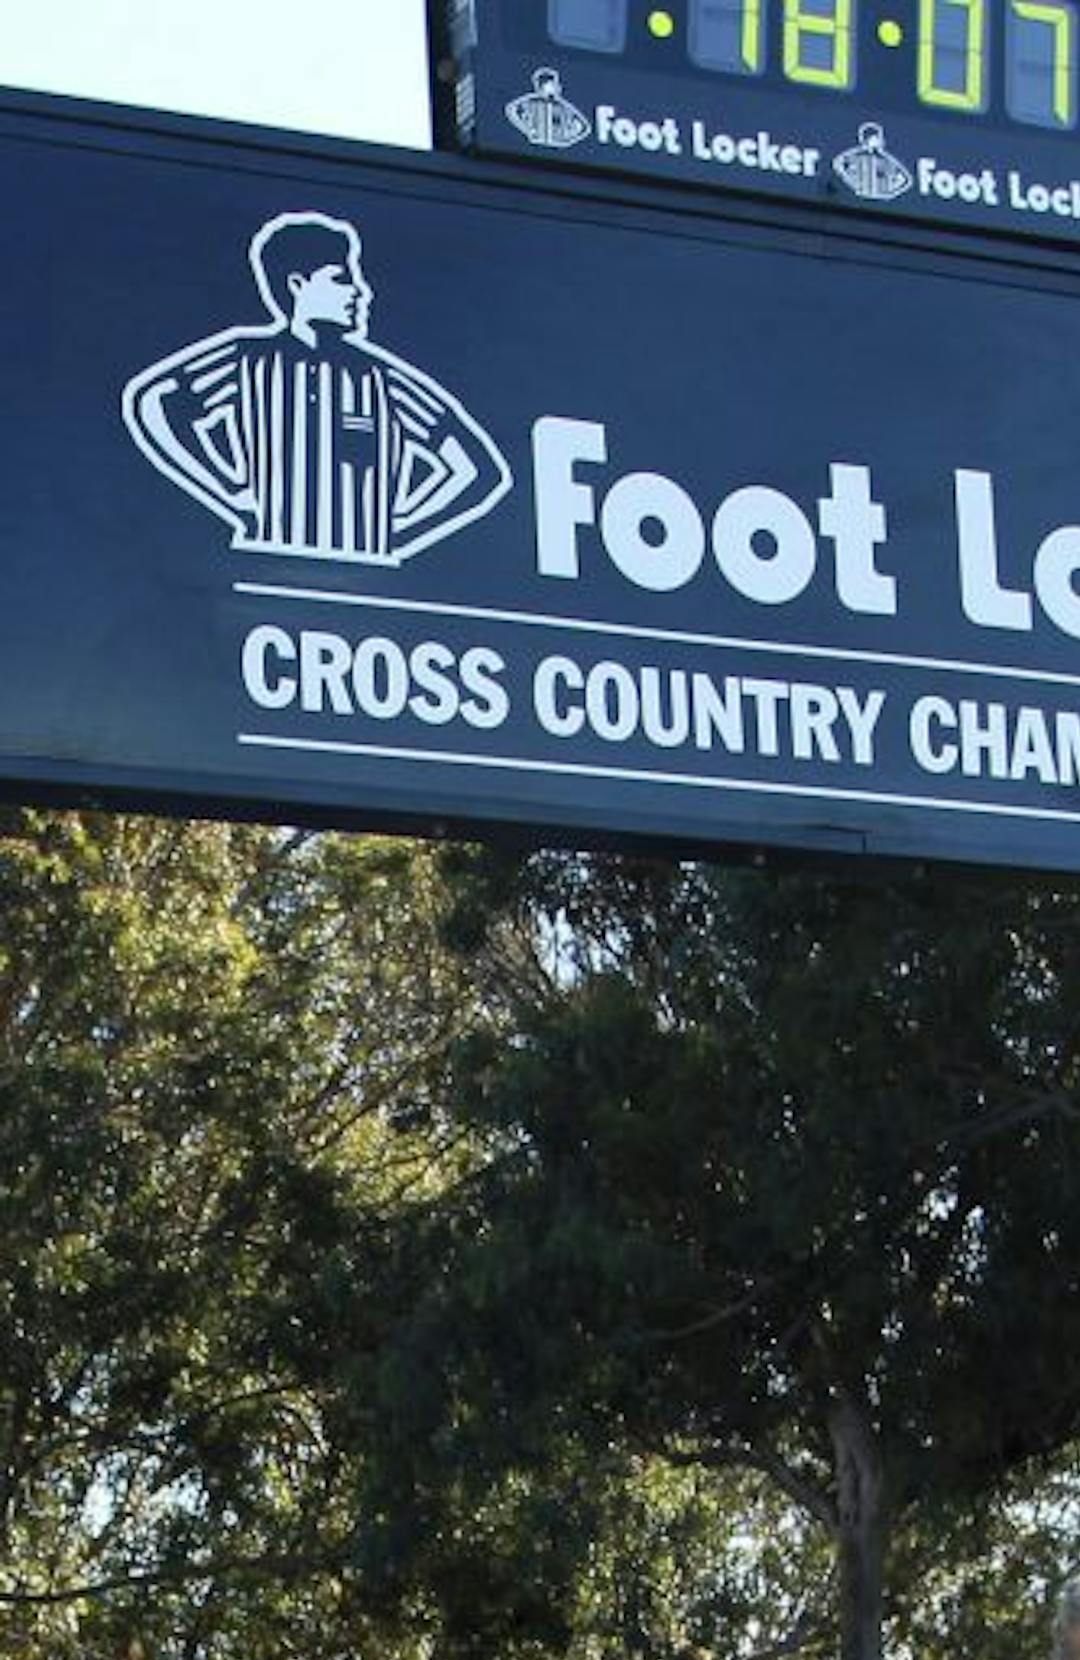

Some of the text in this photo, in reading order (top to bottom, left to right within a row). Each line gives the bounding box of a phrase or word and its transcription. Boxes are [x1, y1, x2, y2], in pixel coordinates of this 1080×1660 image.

[596, 105, 819, 176] Foot Locker
[918, 158, 998, 205] Foot
[532, 416, 898, 615] Foot
[241, 624, 510, 729] CROSS
[532, 655, 886, 765] COUNTRY
